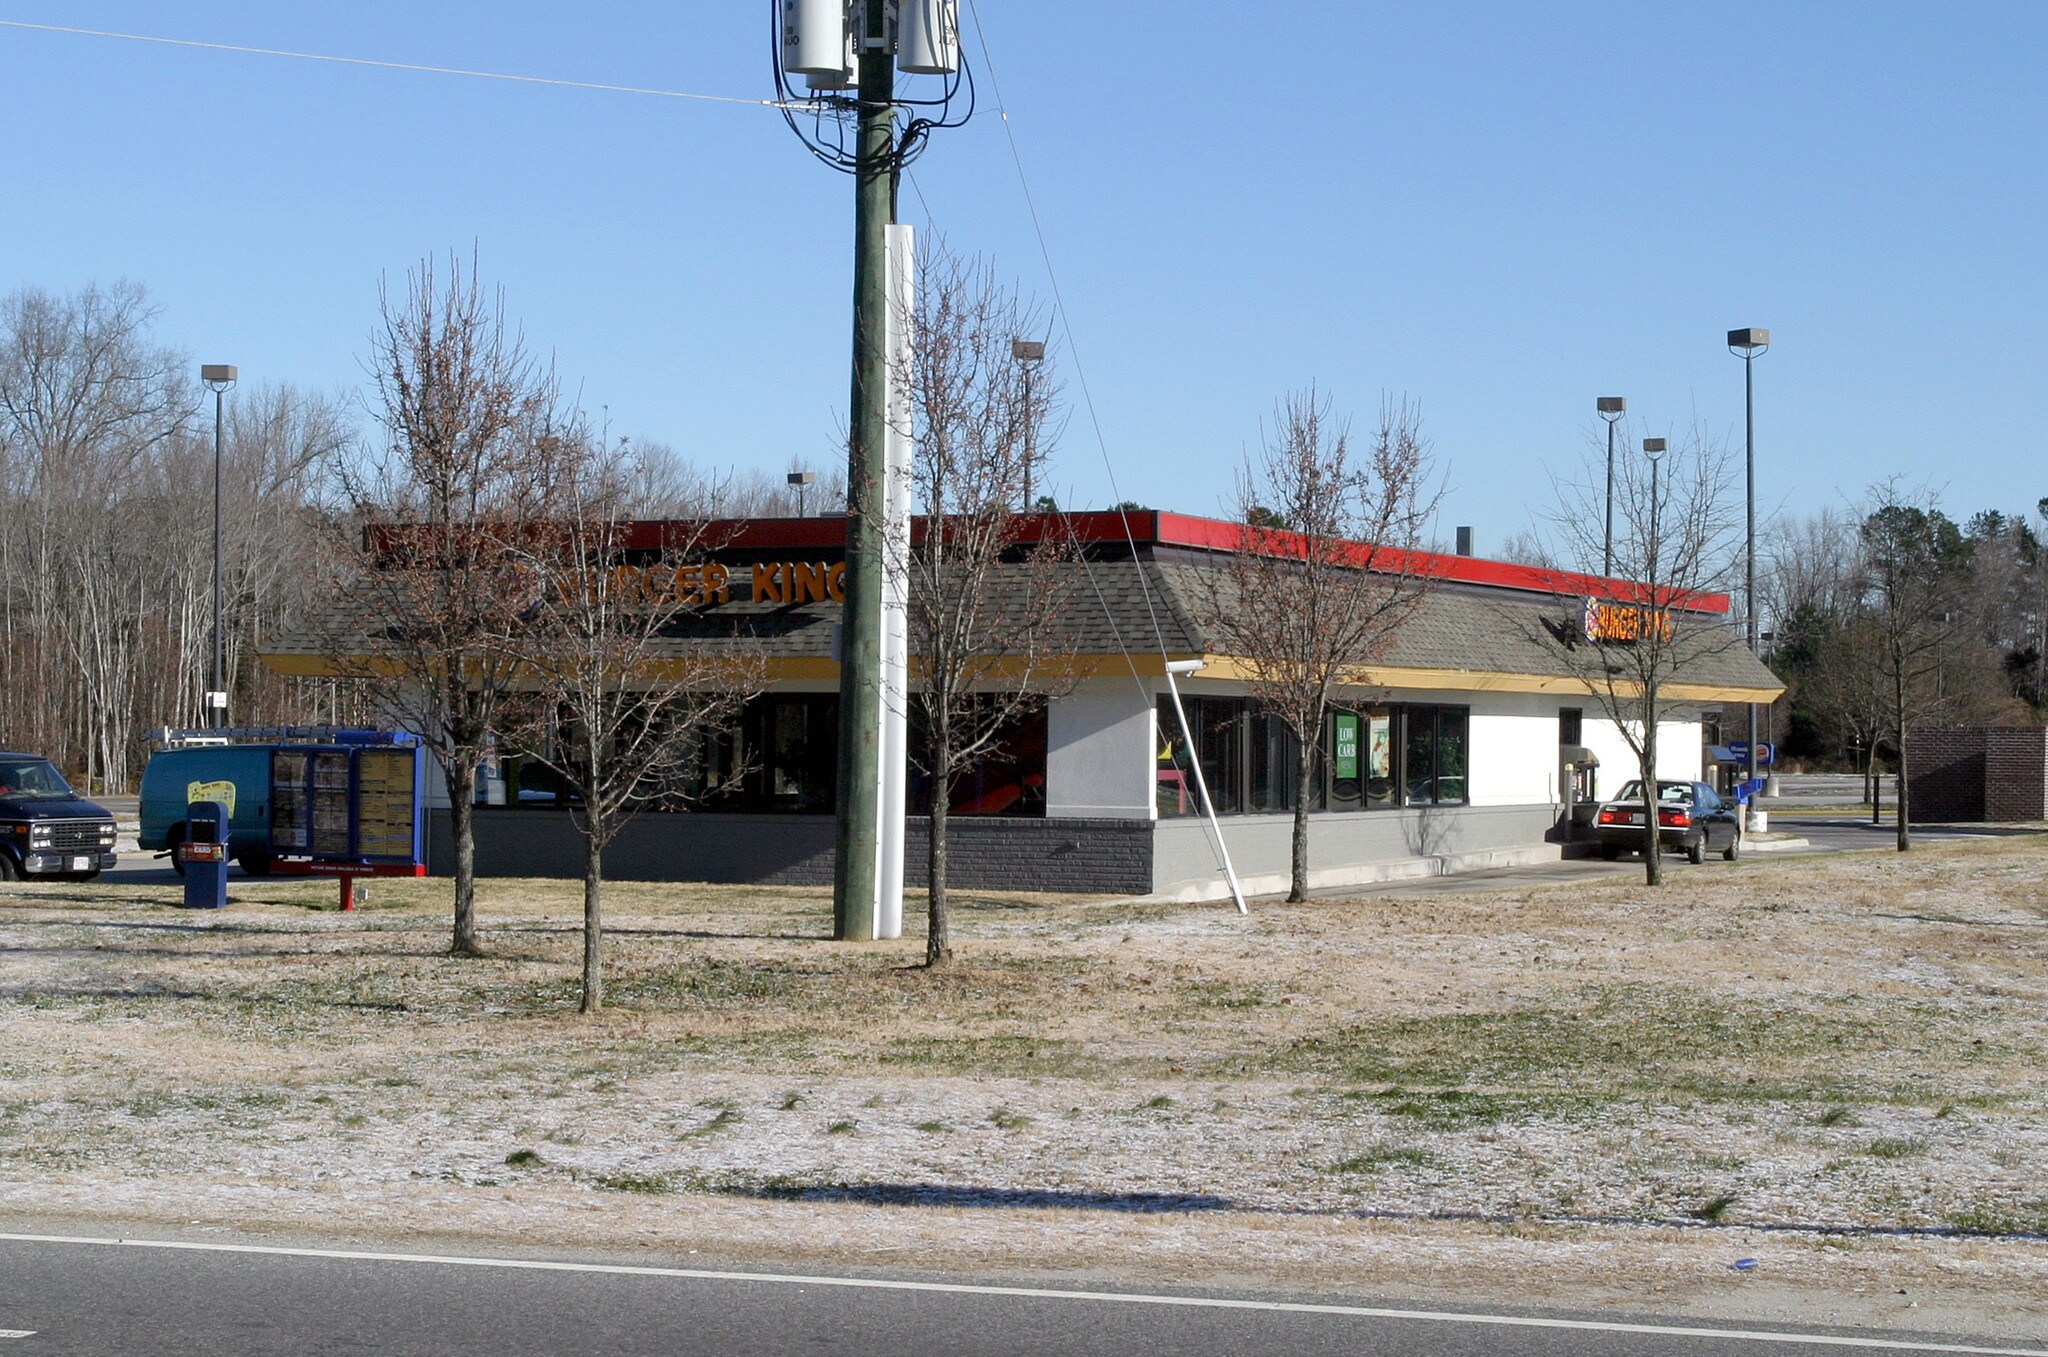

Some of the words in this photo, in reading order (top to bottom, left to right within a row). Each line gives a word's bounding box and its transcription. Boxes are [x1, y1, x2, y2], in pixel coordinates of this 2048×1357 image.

[1644, 610, 1672, 643] KNG
[1340, 727, 1354, 741] LOW
[1337, 743, 1356, 757] CARB
